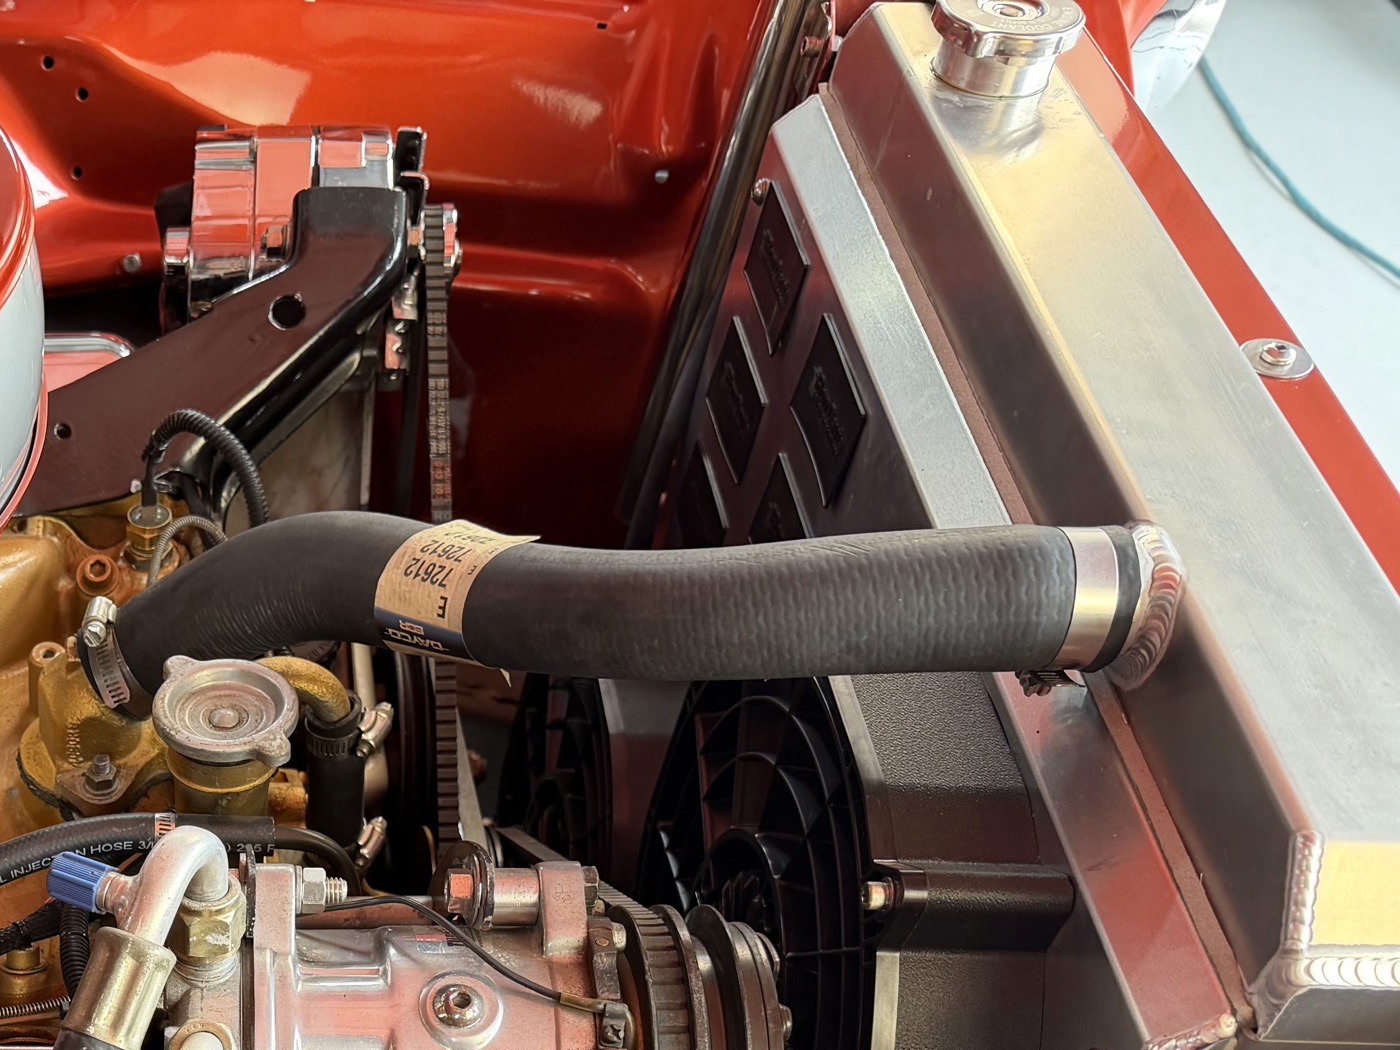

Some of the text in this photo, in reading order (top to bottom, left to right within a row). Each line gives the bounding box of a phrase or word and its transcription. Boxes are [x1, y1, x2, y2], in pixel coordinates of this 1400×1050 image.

[420, 540, 473, 563] 72612
[404, 557, 455, 588] 72612
[437, 596, 449, 619] E
[386, 628, 446, 650] DAYCO
[90, 841, 134, 855] HOSE
